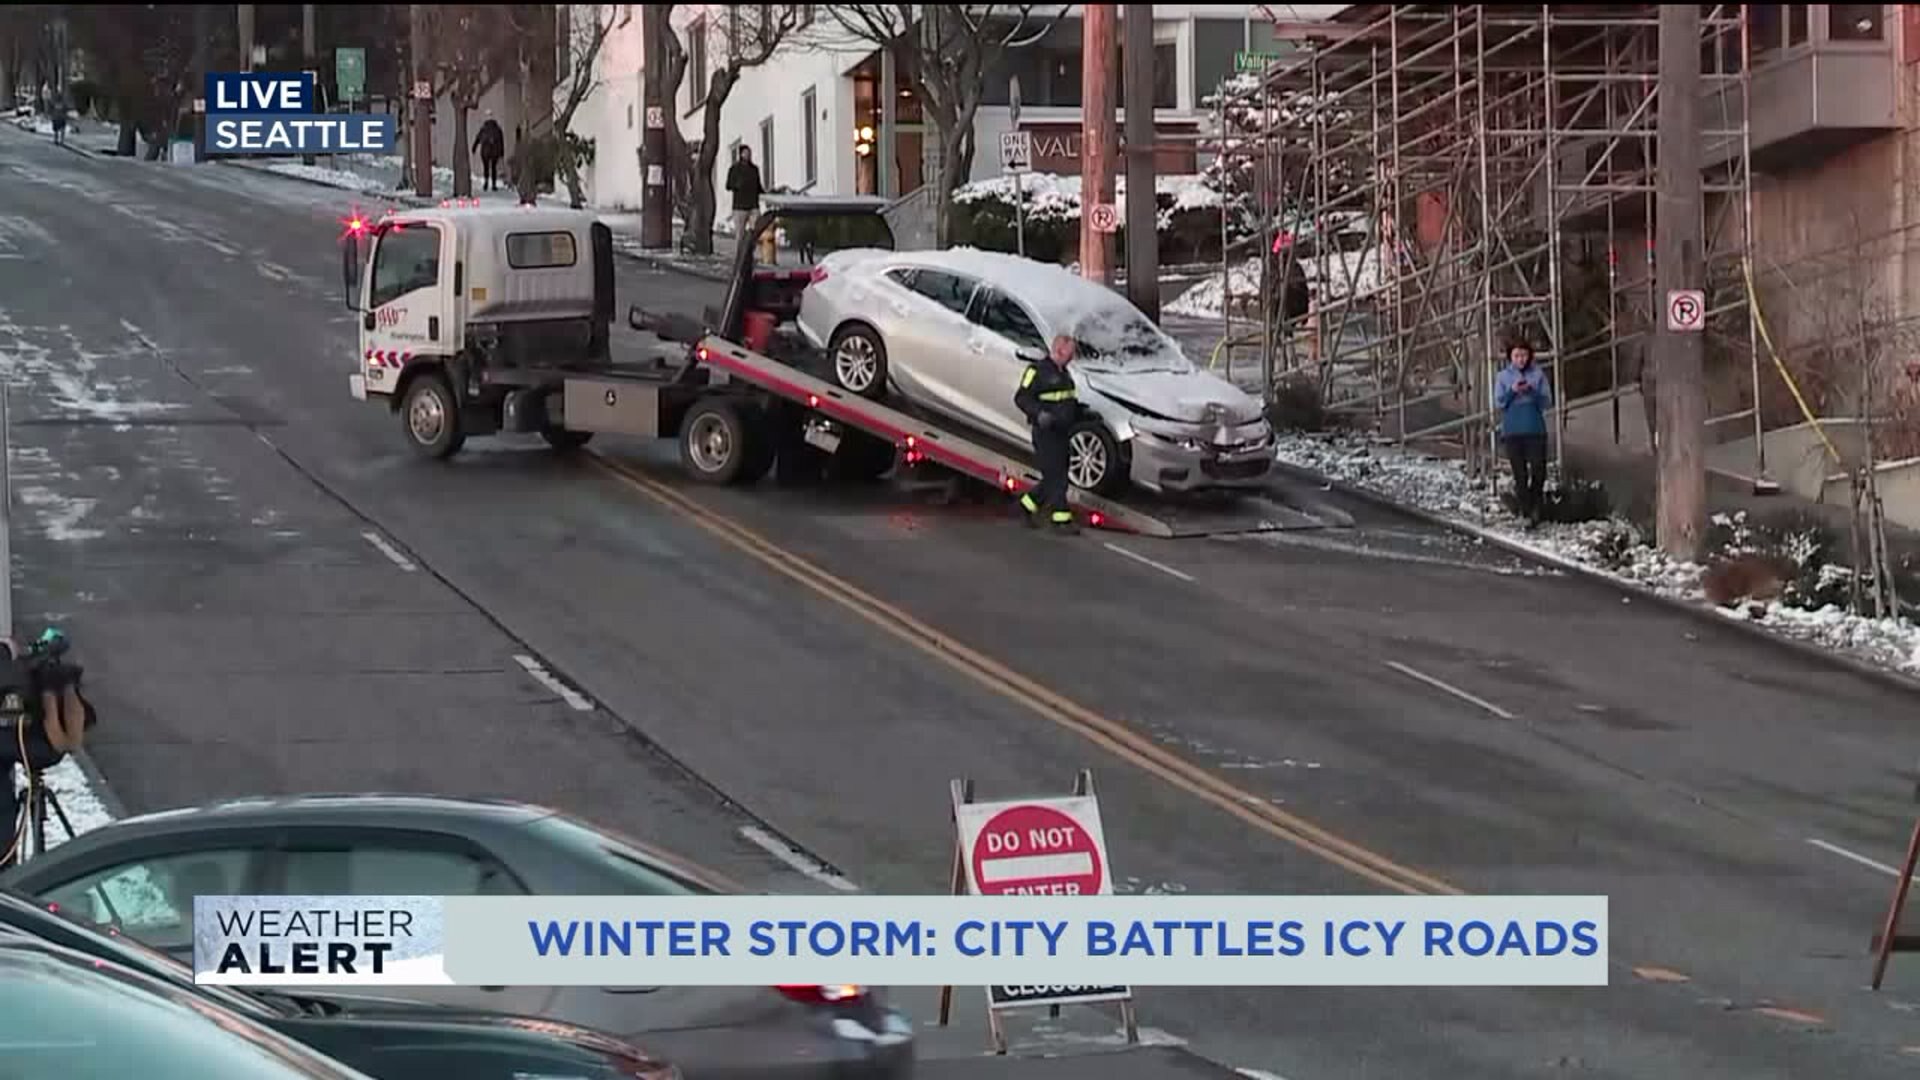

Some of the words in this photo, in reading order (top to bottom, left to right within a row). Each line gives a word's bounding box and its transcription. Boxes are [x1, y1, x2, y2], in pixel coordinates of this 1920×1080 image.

[1003, 135, 1027, 145] ONE
[1004, 145, 1029, 157] WAY
[987, 831, 1019, 853] DO
[1029, 827, 1075, 850] NOT
